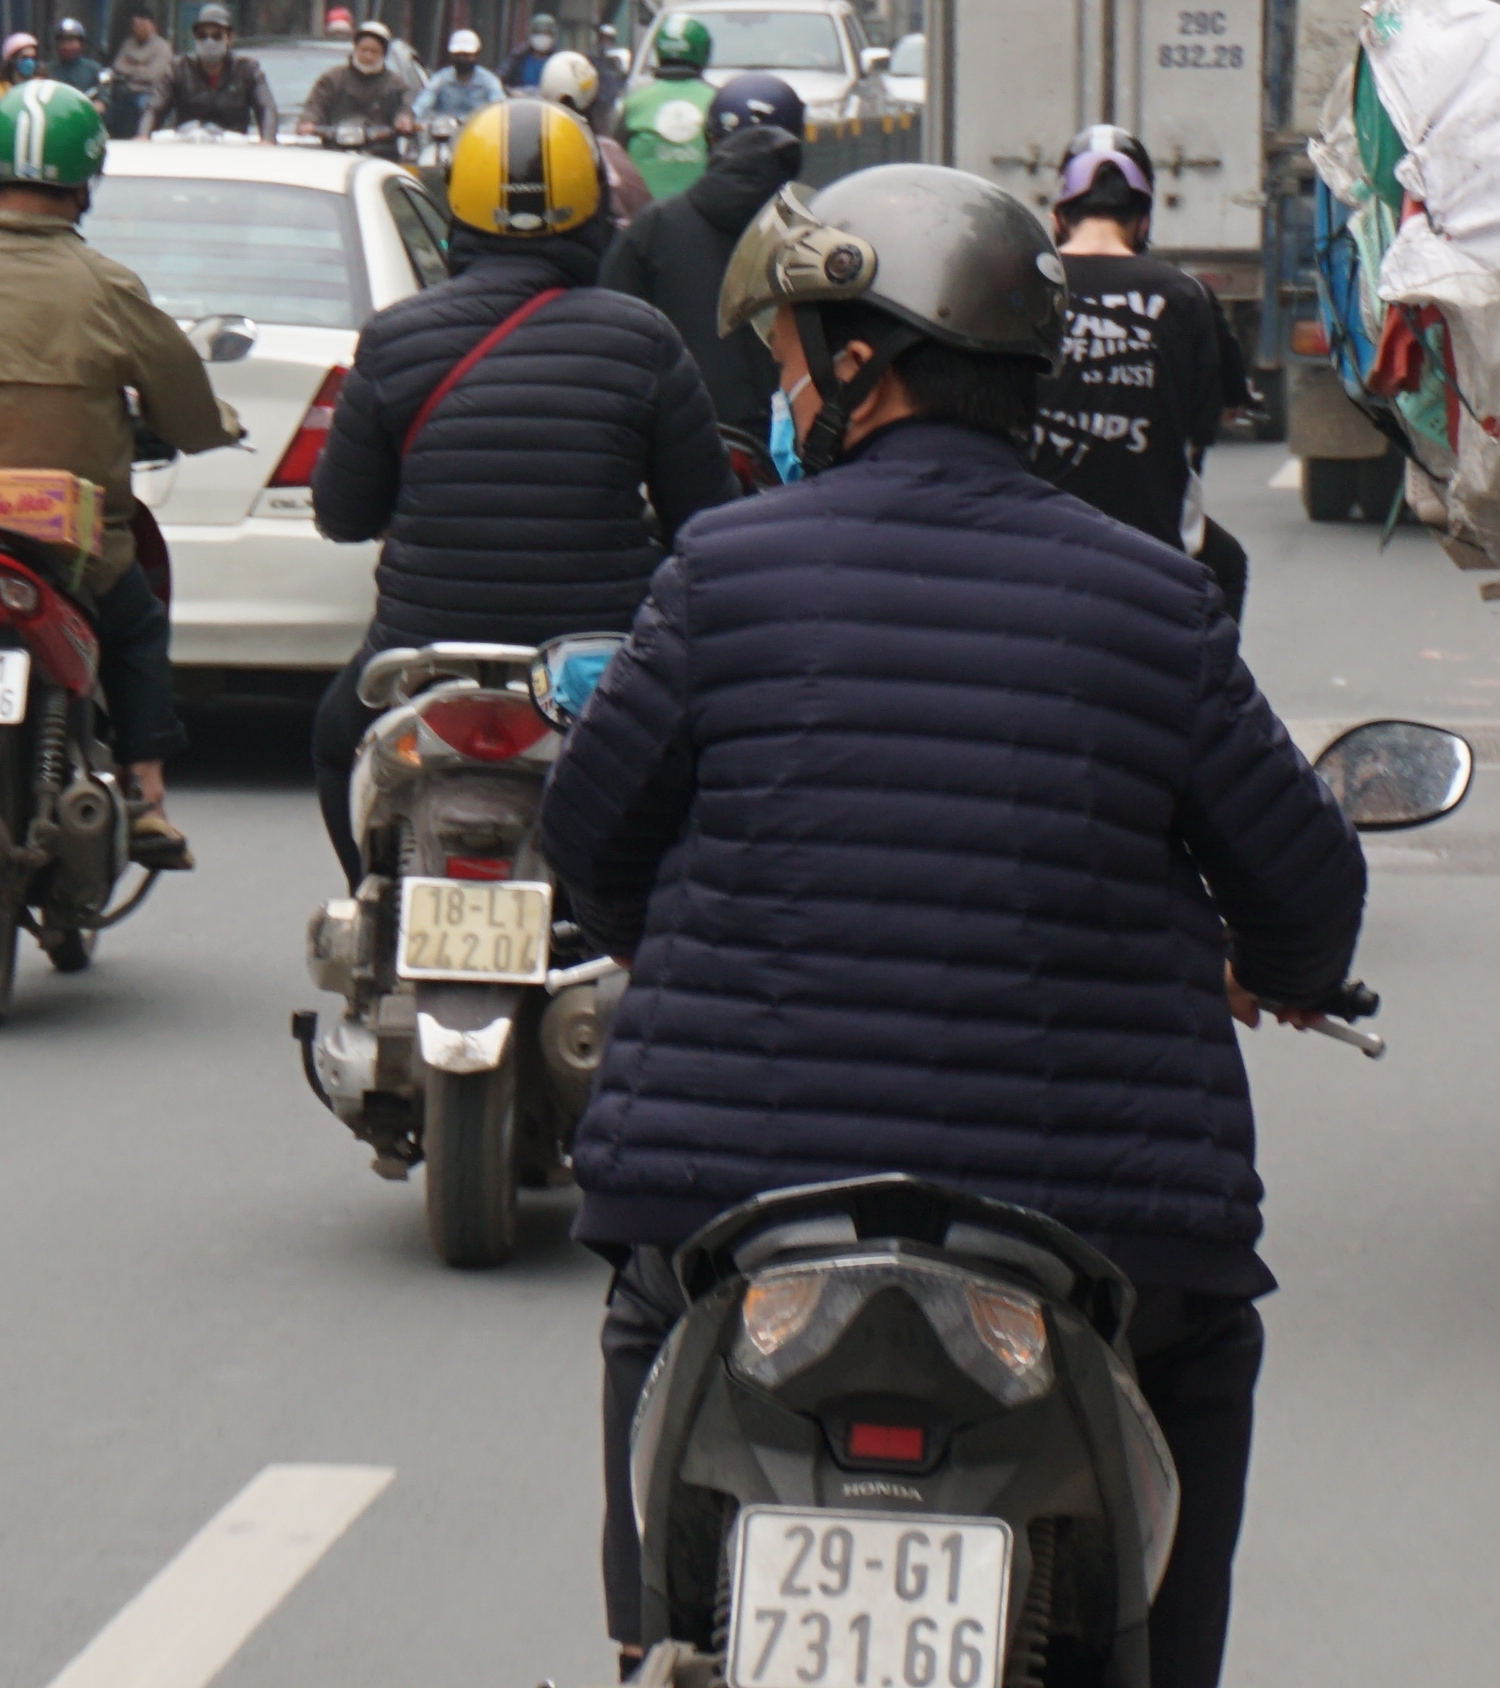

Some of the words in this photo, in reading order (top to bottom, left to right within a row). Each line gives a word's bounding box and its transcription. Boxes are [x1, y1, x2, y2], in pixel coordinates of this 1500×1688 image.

[1176, 11, 1226, 38] 29C
[842, 1482, 924, 1503] HONDA
[779, 1524, 965, 1605] 29-G1
[752, 1608, 986, 1688] 731.66
